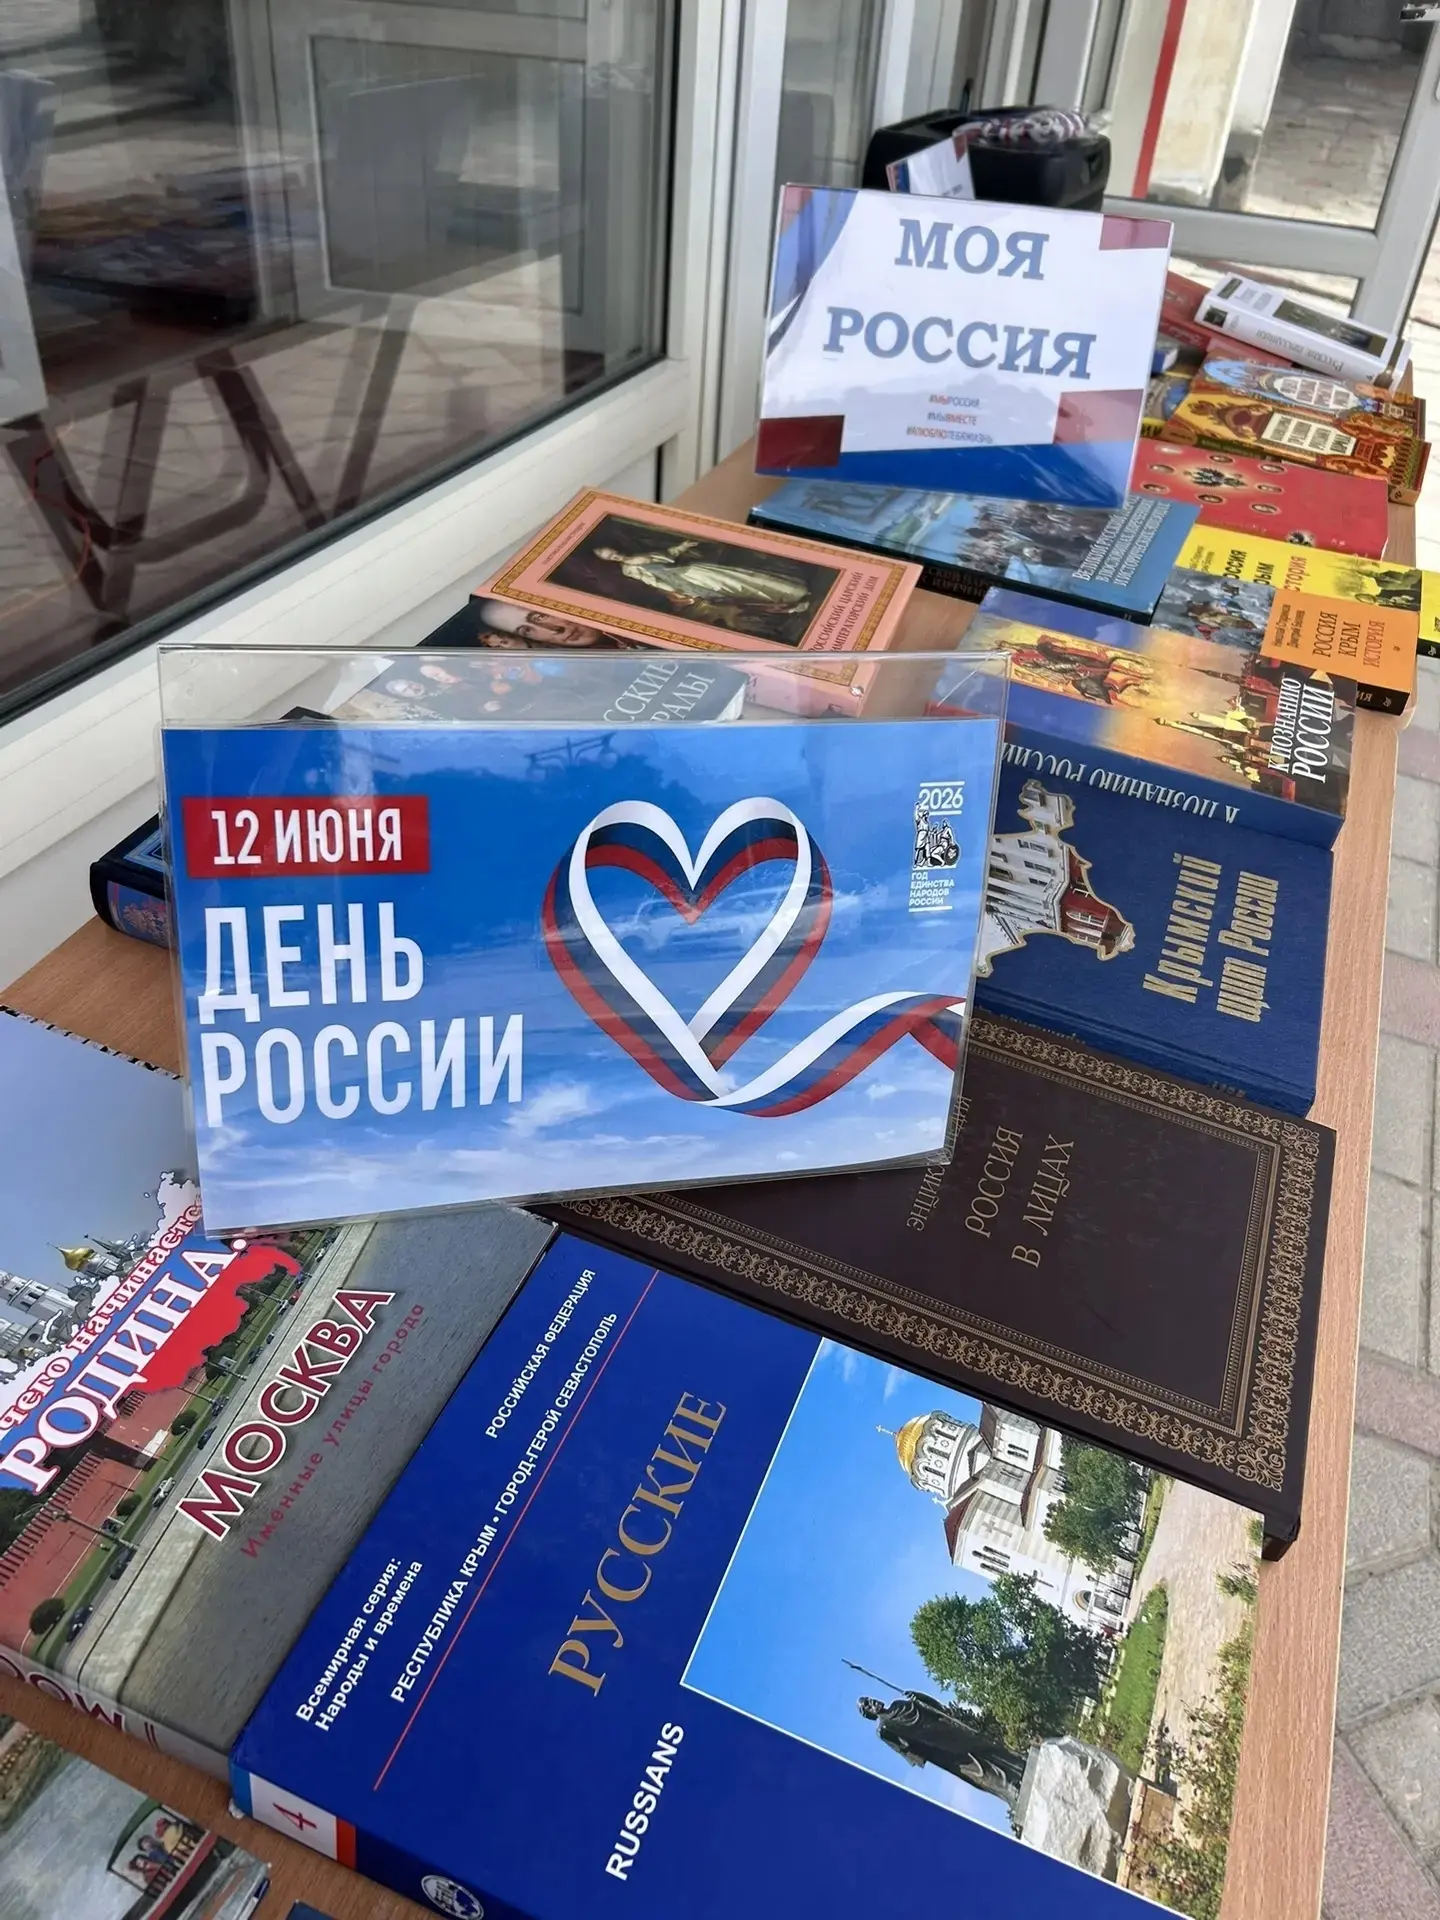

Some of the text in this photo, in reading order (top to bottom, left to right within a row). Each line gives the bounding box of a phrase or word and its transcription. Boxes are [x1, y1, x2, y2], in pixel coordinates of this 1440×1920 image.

[894, 218, 1050, 281] МОЯ
[822, 306, 1097, 380] РОССИЯ
[864, 576, 879, 592] ДОМ
[1223, 549, 1247, 579] ОССИЯ
[1284, 555, 1310, 592] СТОРИЯ
[1313, 611, 1338, 658] РОССИЯ
[1338, 621, 1361, 658] КРЫМ
[1363, 620, 1386, 668] ИСТОРИЯ
[650, 672, 716, 721] РАЛЫ
[1268, 678, 1302, 774] К ПОЗНАНИЮ
[1292, 684, 1335, 784] РОССИИ
[211, 808, 402, 865] 12 ИЮНЯ
[918, 787, 964, 810] 2026
[908, 897, 944, 907] РОССИИ
[910, 879, 955, 890] ЕДИНСТВА
[910, 888, 950, 898] НАРОДОВ
[911, 871, 929, 880] ГОД
[1218, 871, 1279, 957] России
[198, 902, 424, 1024] ДЕНЬ
[1142, 852, 1222, 1004] Крымский
[201, 1014, 523, 1128] РОССИИ
[964, 1126, 1023, 1239] РОССИЯ
[1011, 1134, 1075, 1268] В ЛИЦАХ
[0, 1203, 203, 1432] чего начинаетс
[485, 1268, 595, 1438] РОССИЙСКАЯ ФЕДЕРАЦИЯ
[175, 1289, 396, 1541] МОСКВА
[241, 1453, 323, 1559] Именные
[322, 1380, 374, 1448] улицы
[390, 1312, 617, 1703] РЕСПУБЛИКА КРЫМ ГОРОД-ГЕРОЙ СЕВАСТОПОЛЬ
[548, 1391, 727, 1697] РУССКИЕ
[296, 1557, 402, 1721] Всемирная серия:
[315, 1560, 423, 1731] Народы и времена
[272, 1802, 317, 1831] 4
[604, 1722, 684, 1881] RUSSIANS
